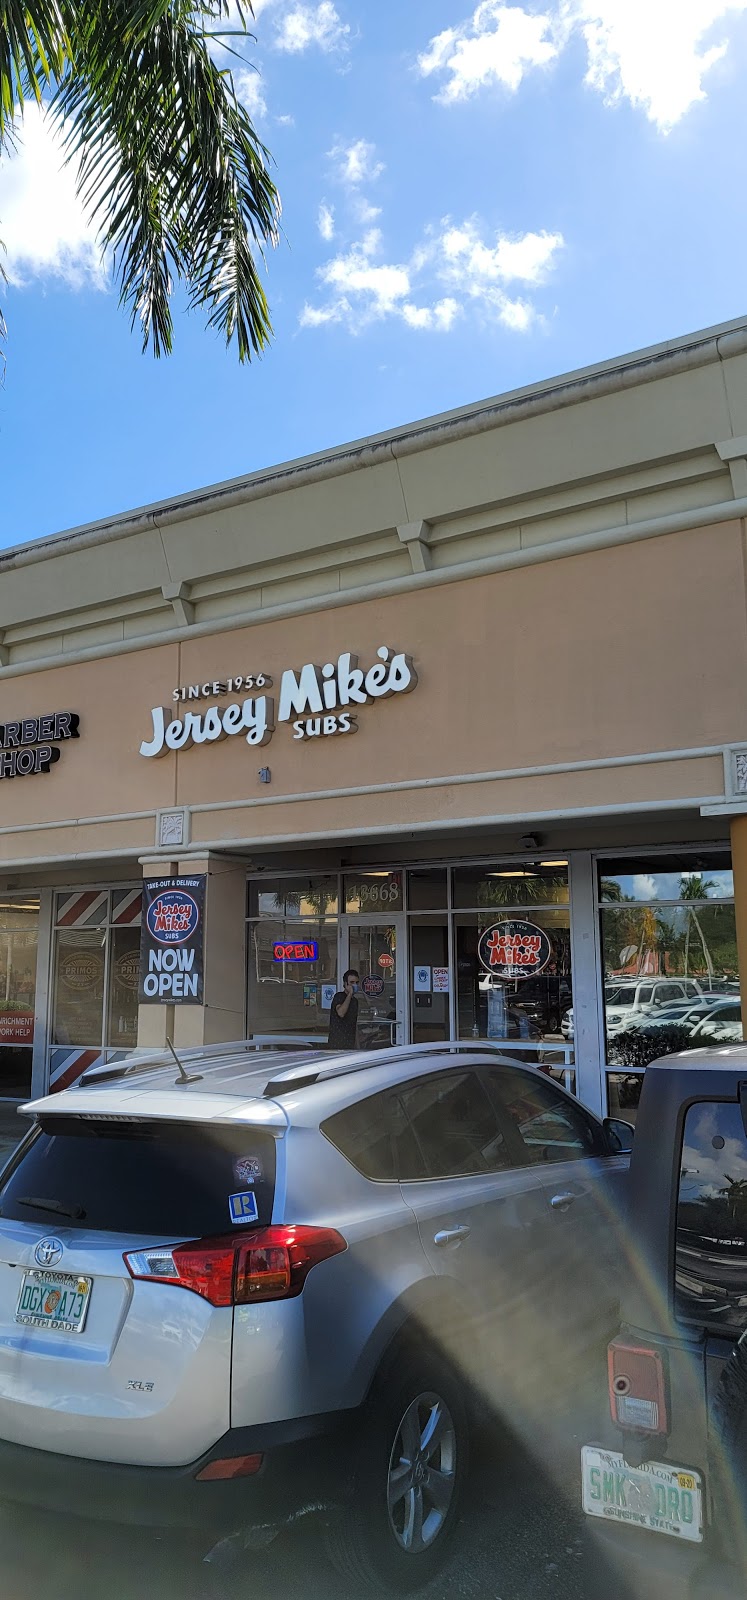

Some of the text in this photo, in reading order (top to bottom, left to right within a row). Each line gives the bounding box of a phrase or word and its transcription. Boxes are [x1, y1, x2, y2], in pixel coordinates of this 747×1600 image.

[173, 673, 267, 701] SINCE 1956
[139, 646, 412, 757] Jersey Mike's
[0, 711, 73, 748] RBER
[293, 712, 351, 739] SUBS
[147, 880, 171, 889] TAKE-OUT
[348, 882, 399, 902] 13668
[153, 900, 193, 920] Jersey
[154, 914, 191, 932] Mike's
[164, 932, 179, 940] SUBS
[487, 930, 541, 952] Jersey
[148, 948, 195, 972] NOW
[273, 944, 315, 959] OPEN
[490, 947, 541, 966] Mike's
[65, 966, 98, 975] PRIMOS
[143, 973, 199, 997] OPEN
[15, 1028, 31, 1037] HELP
[41, 1271, 74, 1281] TOYOTA
[21, 1285, 84, 1319] DGX A73
[16, 1315, 50, 1327] SOUTH
[50, 1320, 79, 1332] DADE
[125, 1380, 155, 1392] XLE
[608, 1459, 673, 1484] MYFLIDA.COM
[589, 1467, 627, 1507] SMK
